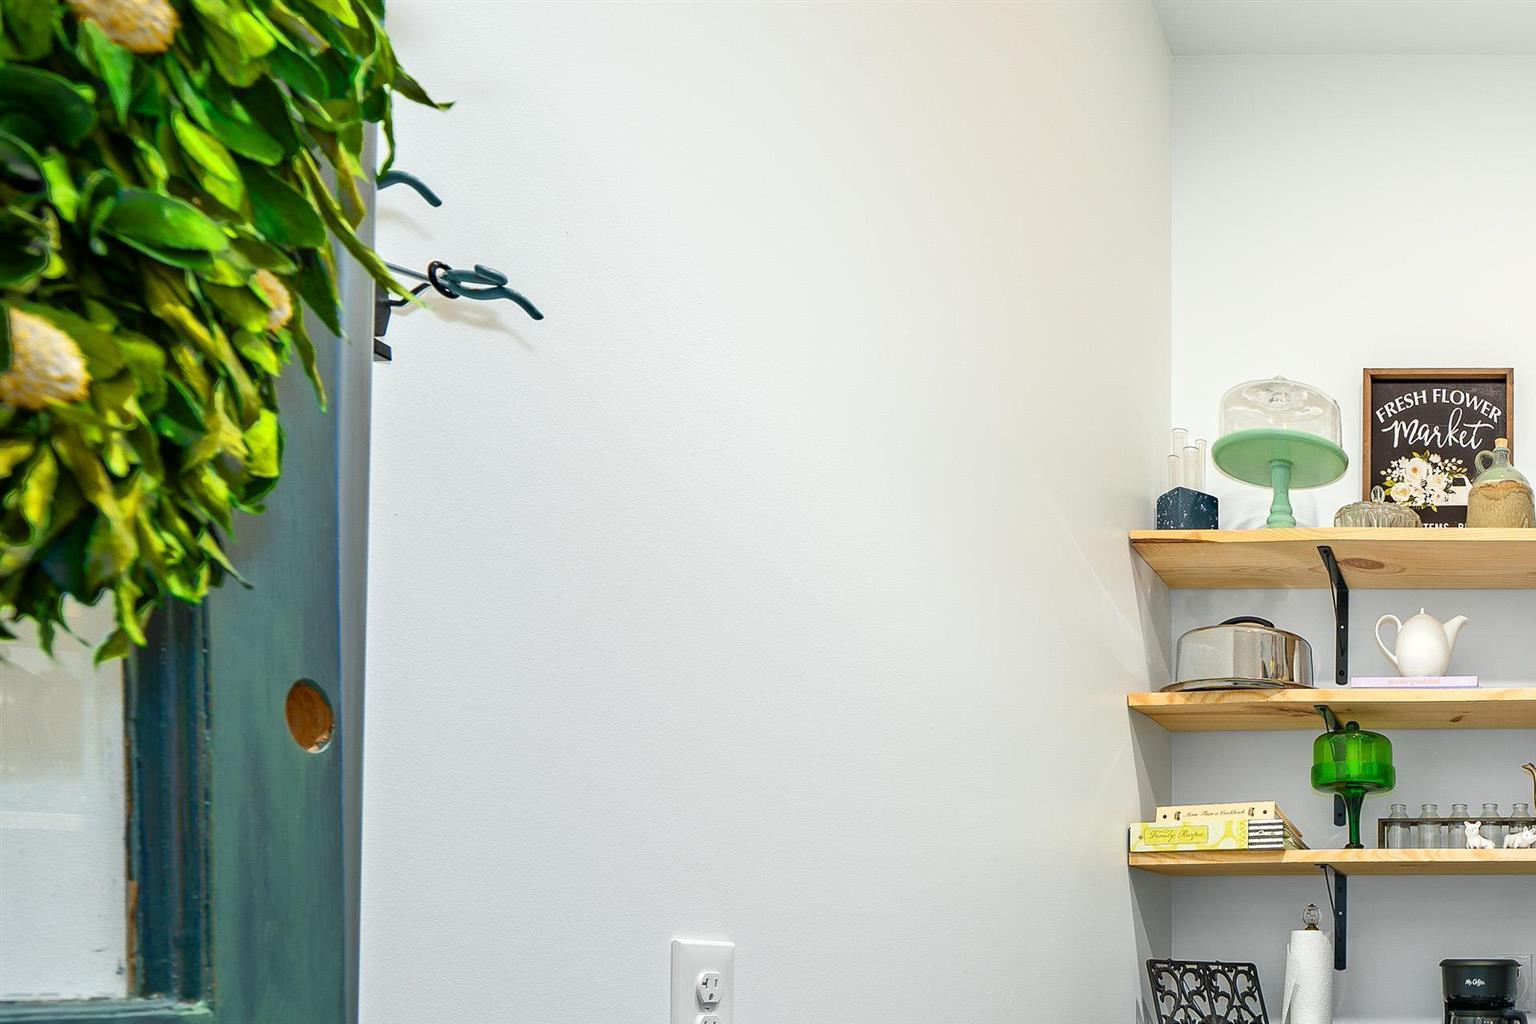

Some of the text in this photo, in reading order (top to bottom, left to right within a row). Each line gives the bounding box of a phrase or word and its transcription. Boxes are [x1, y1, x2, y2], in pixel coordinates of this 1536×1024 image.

[1375, 388, 1502, 423] FRESH FLOWER
[1381, 407, 1495, 449] Market
